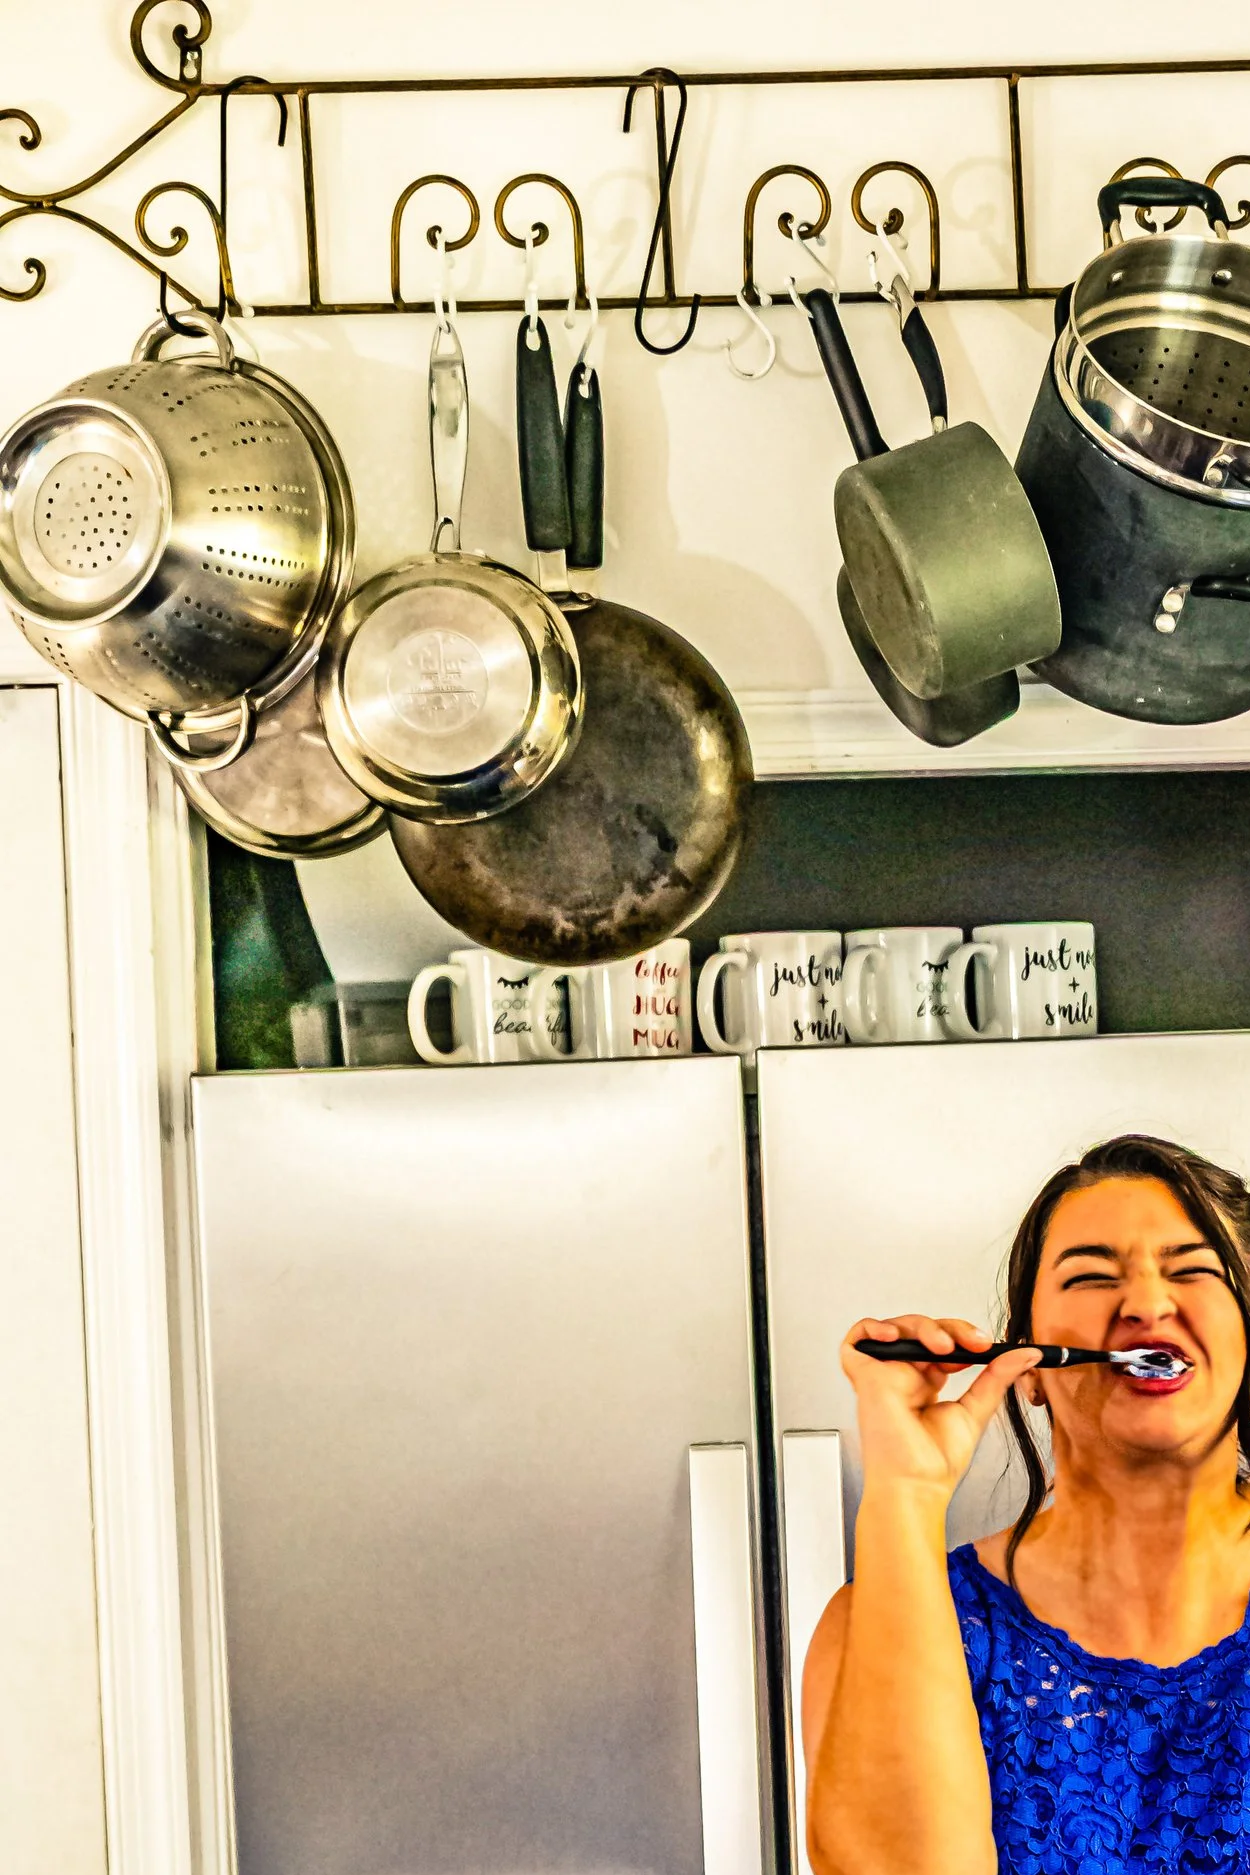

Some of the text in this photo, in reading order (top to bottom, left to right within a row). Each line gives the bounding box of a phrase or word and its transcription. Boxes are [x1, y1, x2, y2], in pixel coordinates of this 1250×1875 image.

[769, 954, 821, 997] just
[1021, 938, 1072, 981] just
[632, 1028, 680, 1050] MUG
